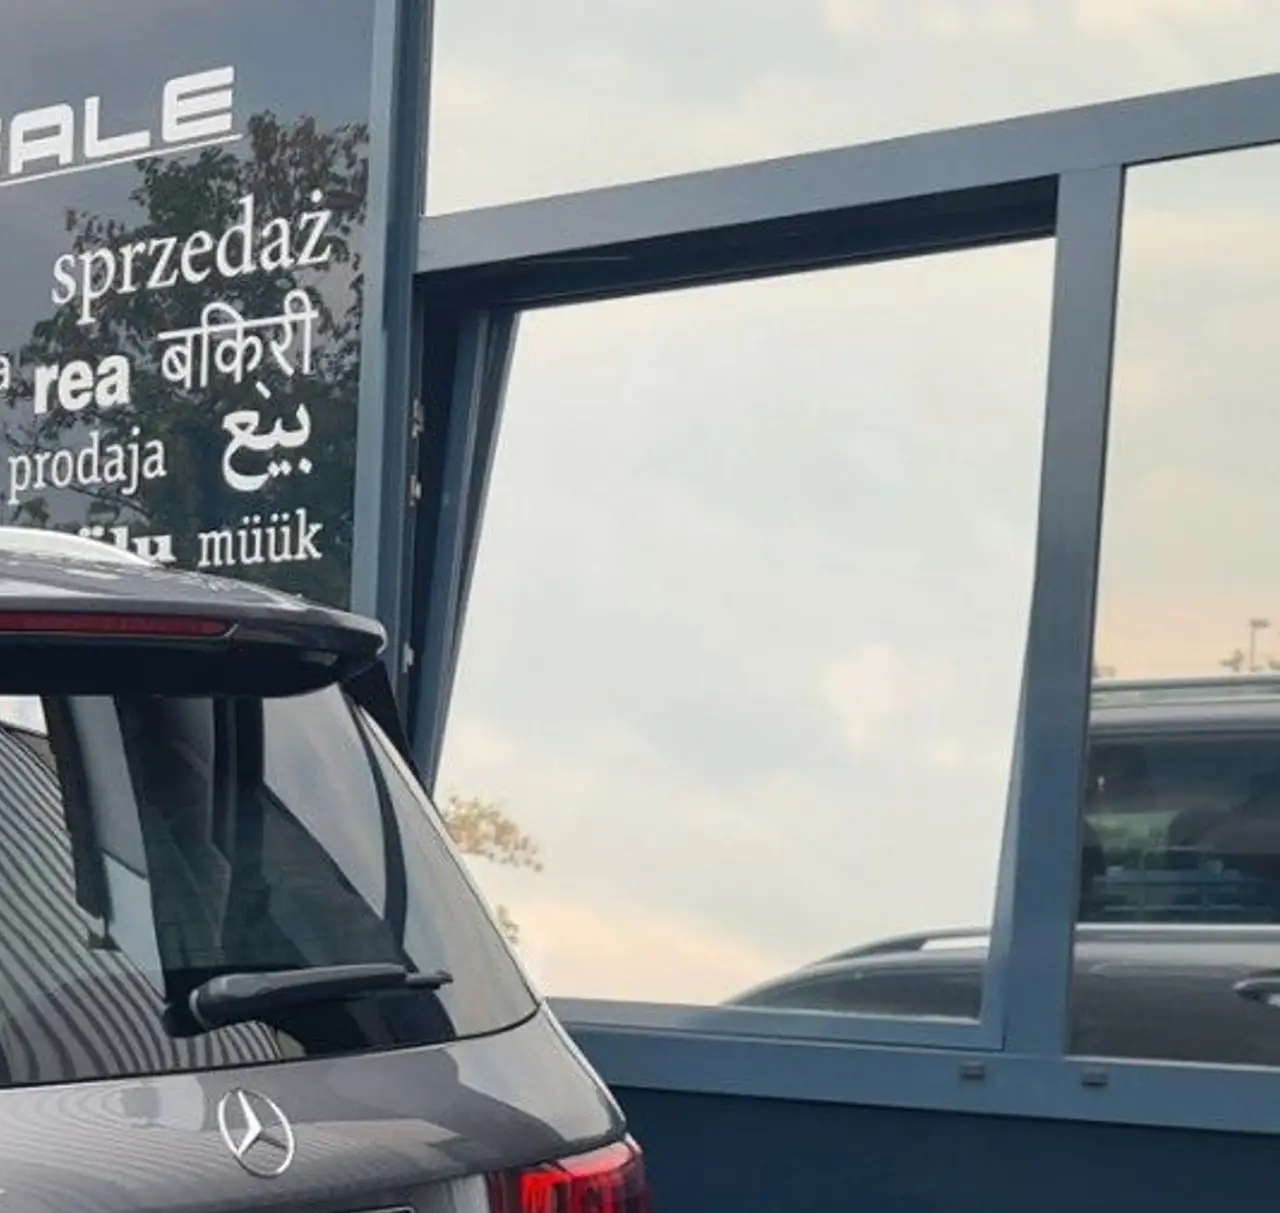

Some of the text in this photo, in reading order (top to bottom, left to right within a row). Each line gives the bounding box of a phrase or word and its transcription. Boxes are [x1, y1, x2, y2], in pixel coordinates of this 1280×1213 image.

[51, 189, 332, 327] sprzedaż
[33, 353, 133, 415] rea
[7, 427, 168, 506] prodaja
[197, 507, 324, 569] müük
